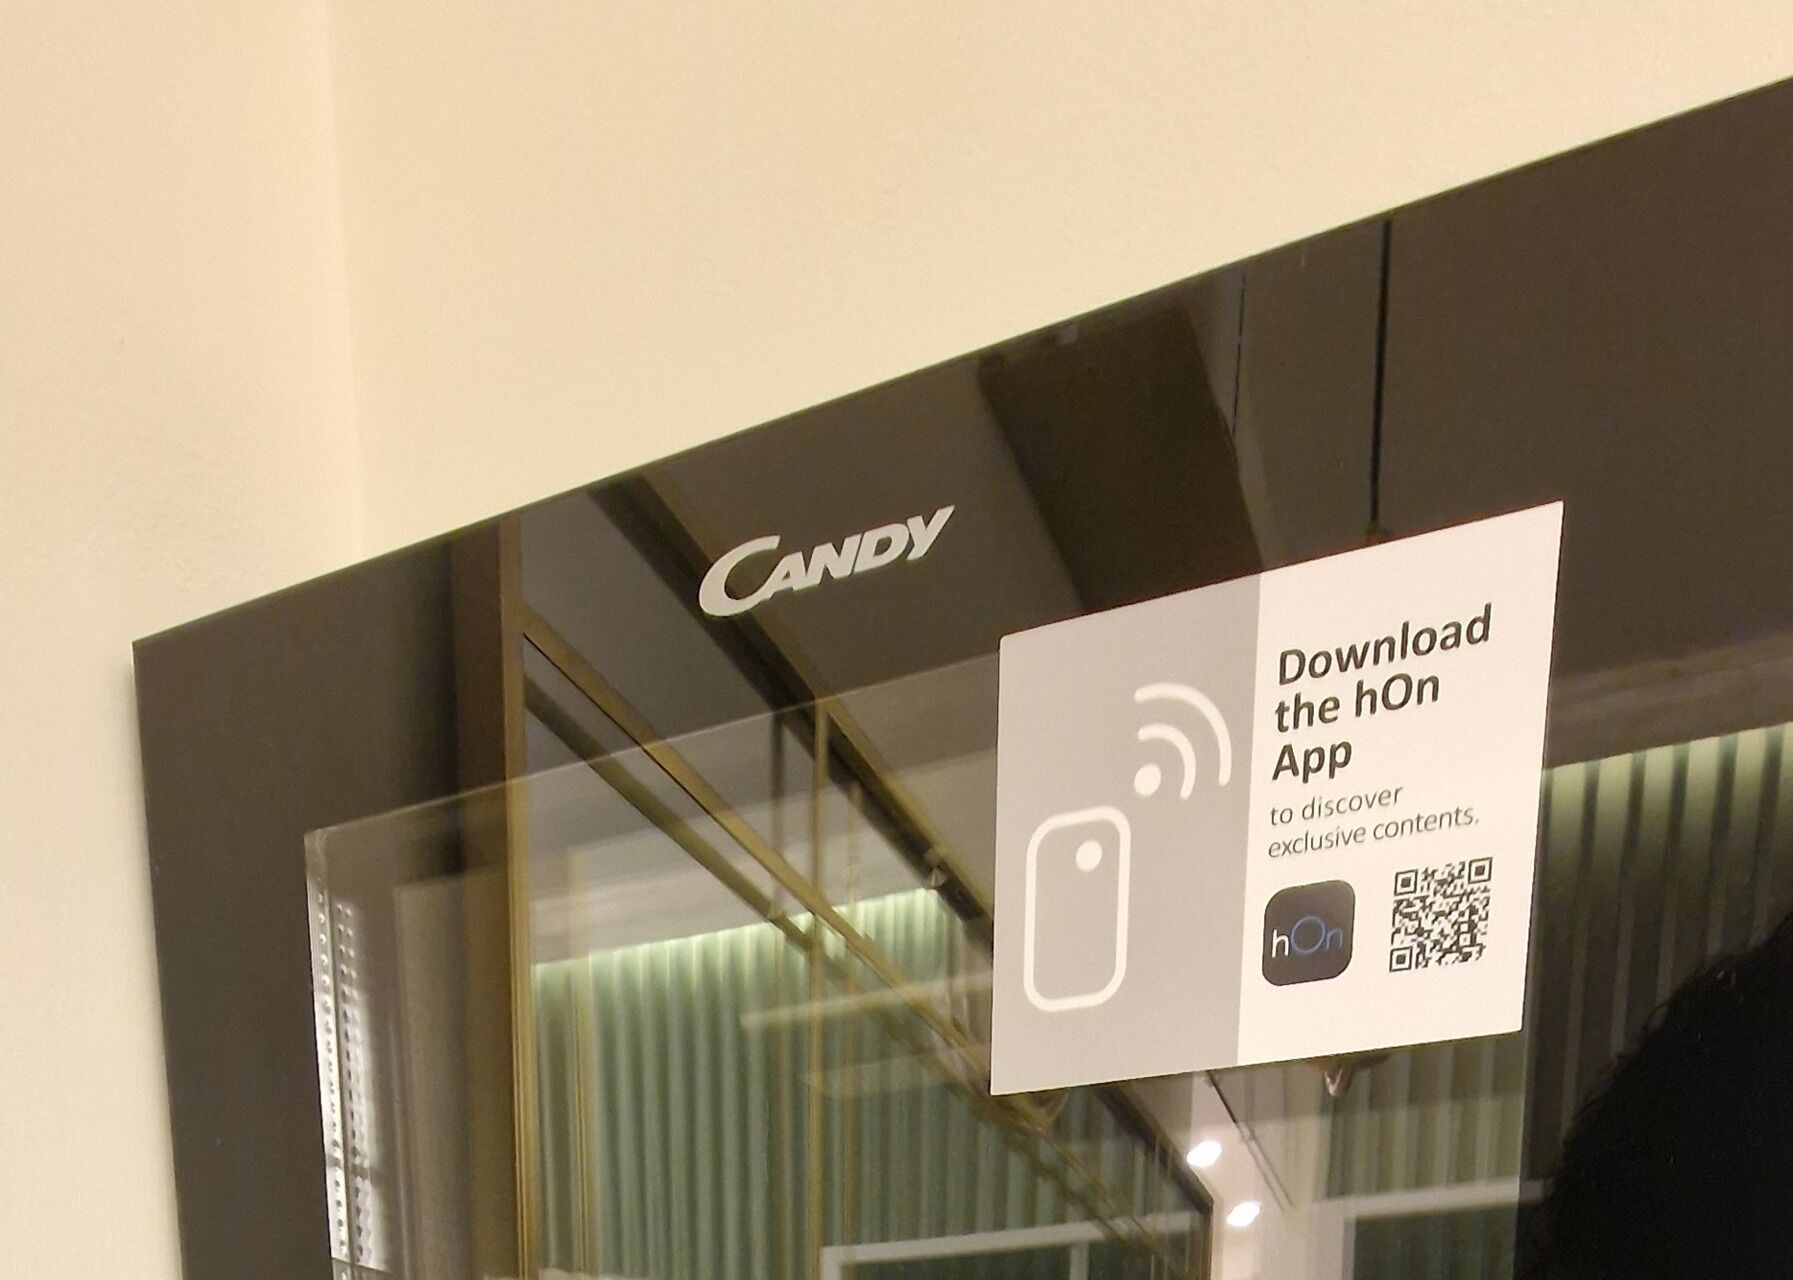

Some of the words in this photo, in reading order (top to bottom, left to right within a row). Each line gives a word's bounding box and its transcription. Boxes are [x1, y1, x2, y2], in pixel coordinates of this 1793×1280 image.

[698, 504, 955, 617] CANDY
[1278, 602, 1492, 686] Download
[1274, 692, 1341, 733] the
[1355, 673, 1440, 718] hOn
[1272, 741, 1353, 784] App
[1268, 825, 1367, 858] exclusive
[1373, 806, 1480, 841] contents.
[1270, 807, 1294, 826] to
[1301, 786, 1403, 820] discover
[1271, 915, 1344, 958] hOn
